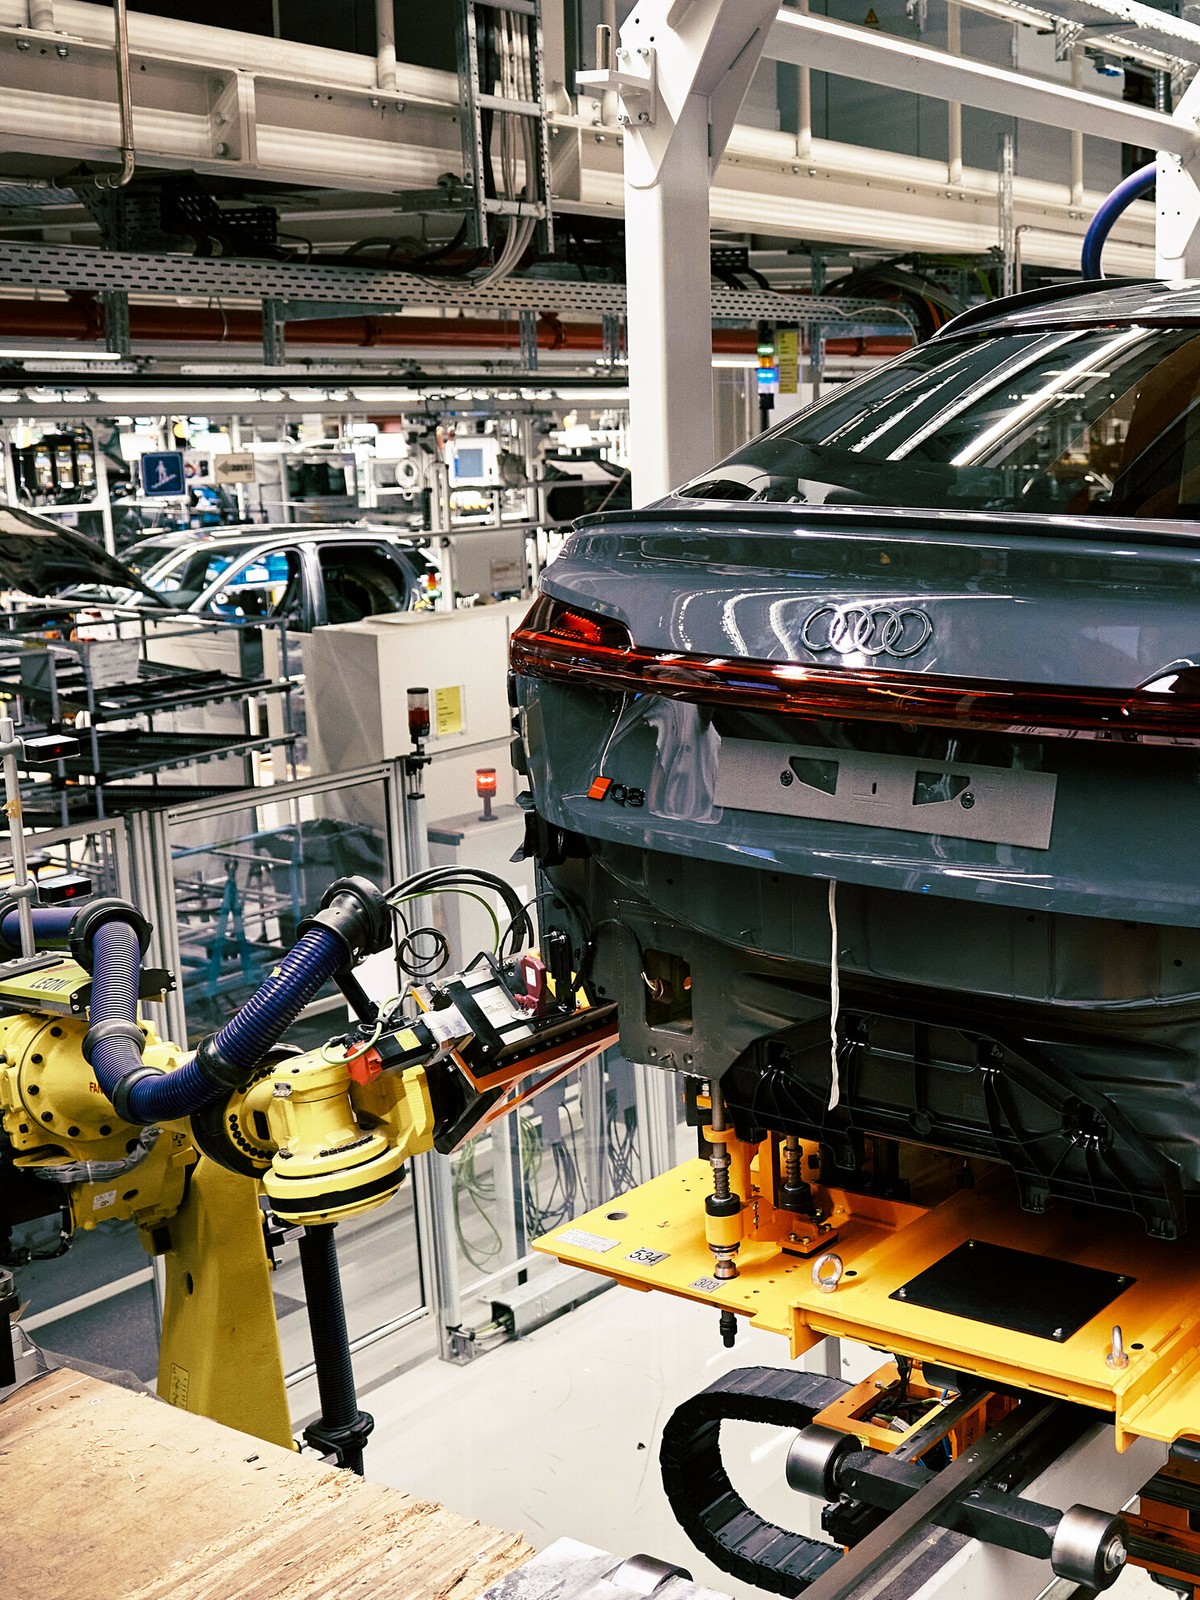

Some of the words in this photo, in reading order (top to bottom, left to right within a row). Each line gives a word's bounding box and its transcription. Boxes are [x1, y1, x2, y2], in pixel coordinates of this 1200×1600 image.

[610, 783, 646, 807] Q8
[629, 1249, 663, 1263] 534
[694, 1278, 720, 1291] 303
